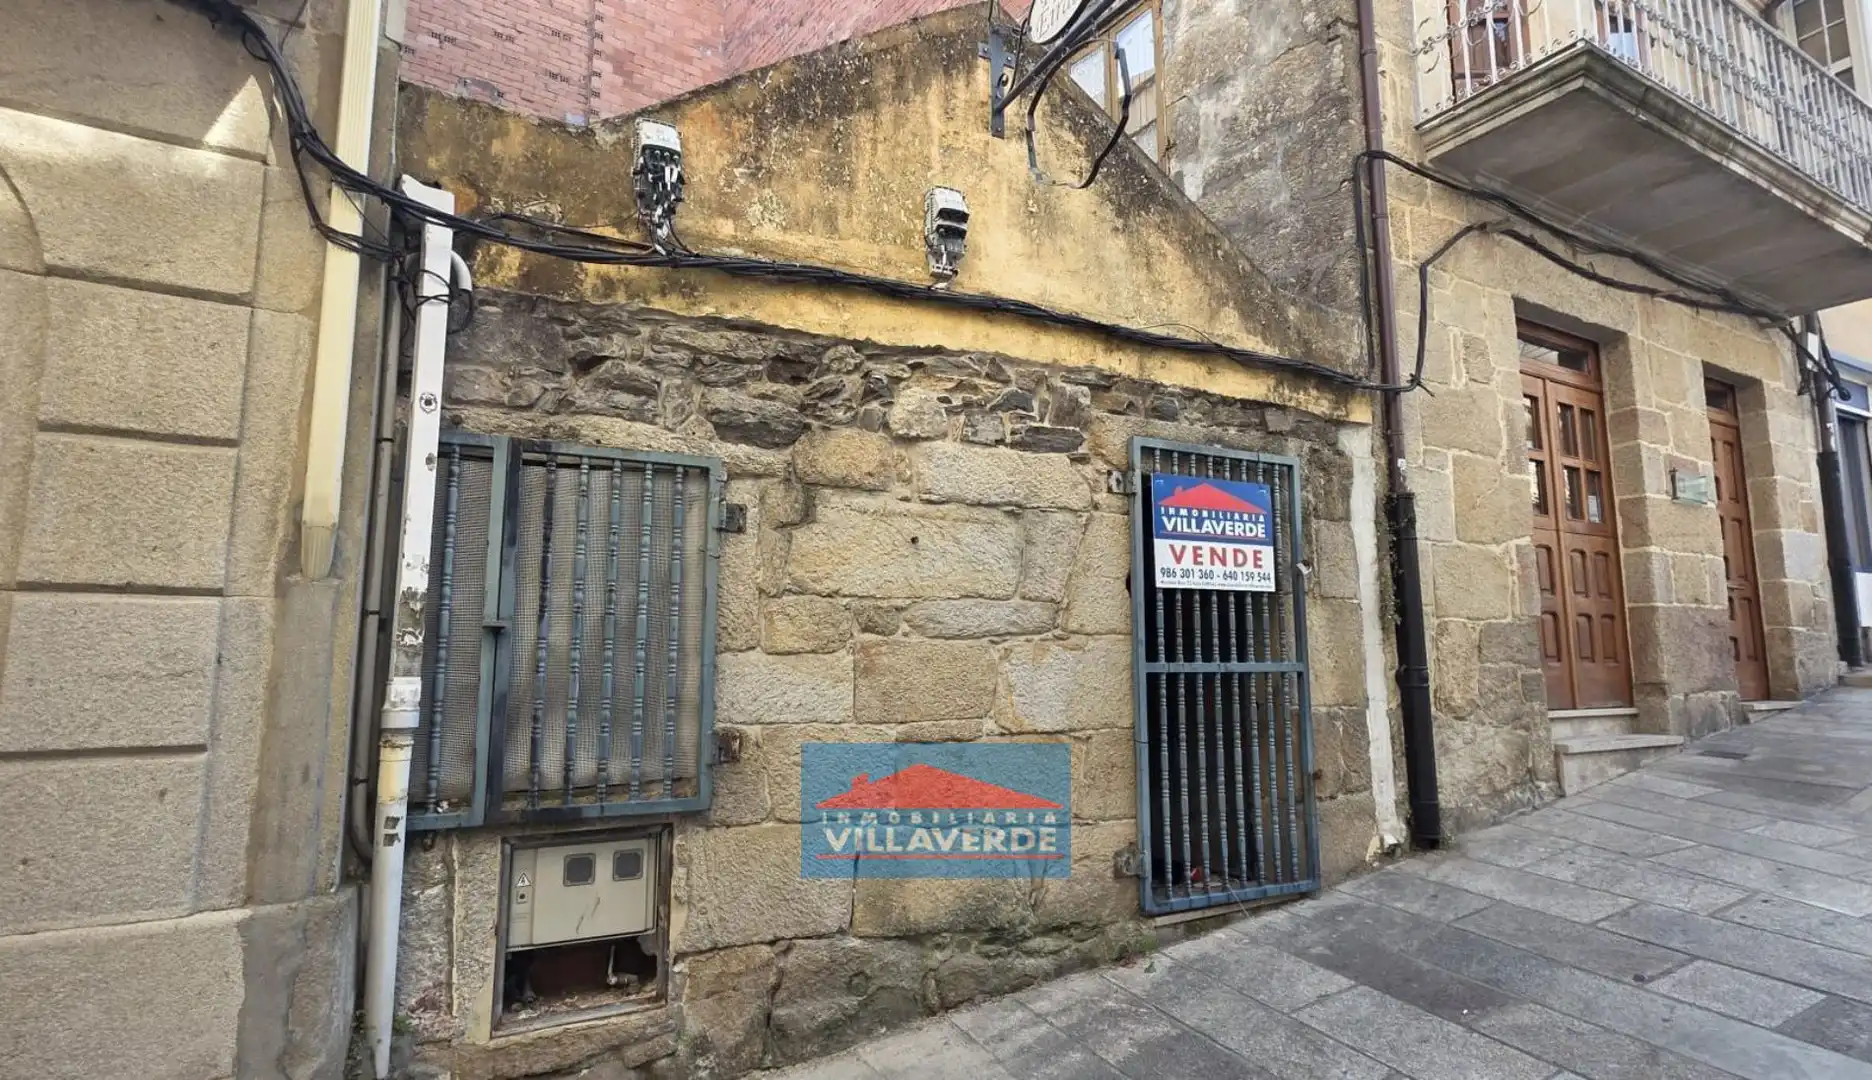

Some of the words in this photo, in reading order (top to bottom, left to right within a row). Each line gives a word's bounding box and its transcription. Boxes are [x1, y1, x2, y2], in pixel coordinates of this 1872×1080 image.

[1160, 506, 1265, 522] INMOBILIARIA
[1161, 516, 1266, 538] VILLAVERDE
[1168, 543, 1264, 569] VENDE
[1160, 567, 1177, 578] 986
[1180, 568, 1195, 578] 301
[1199, 569, 1215, 580] 360
[1222, 570, 1238, 581] 640
[1241, 571, 1255, 581] 159
[1257, 571, 1272, 582] 544
